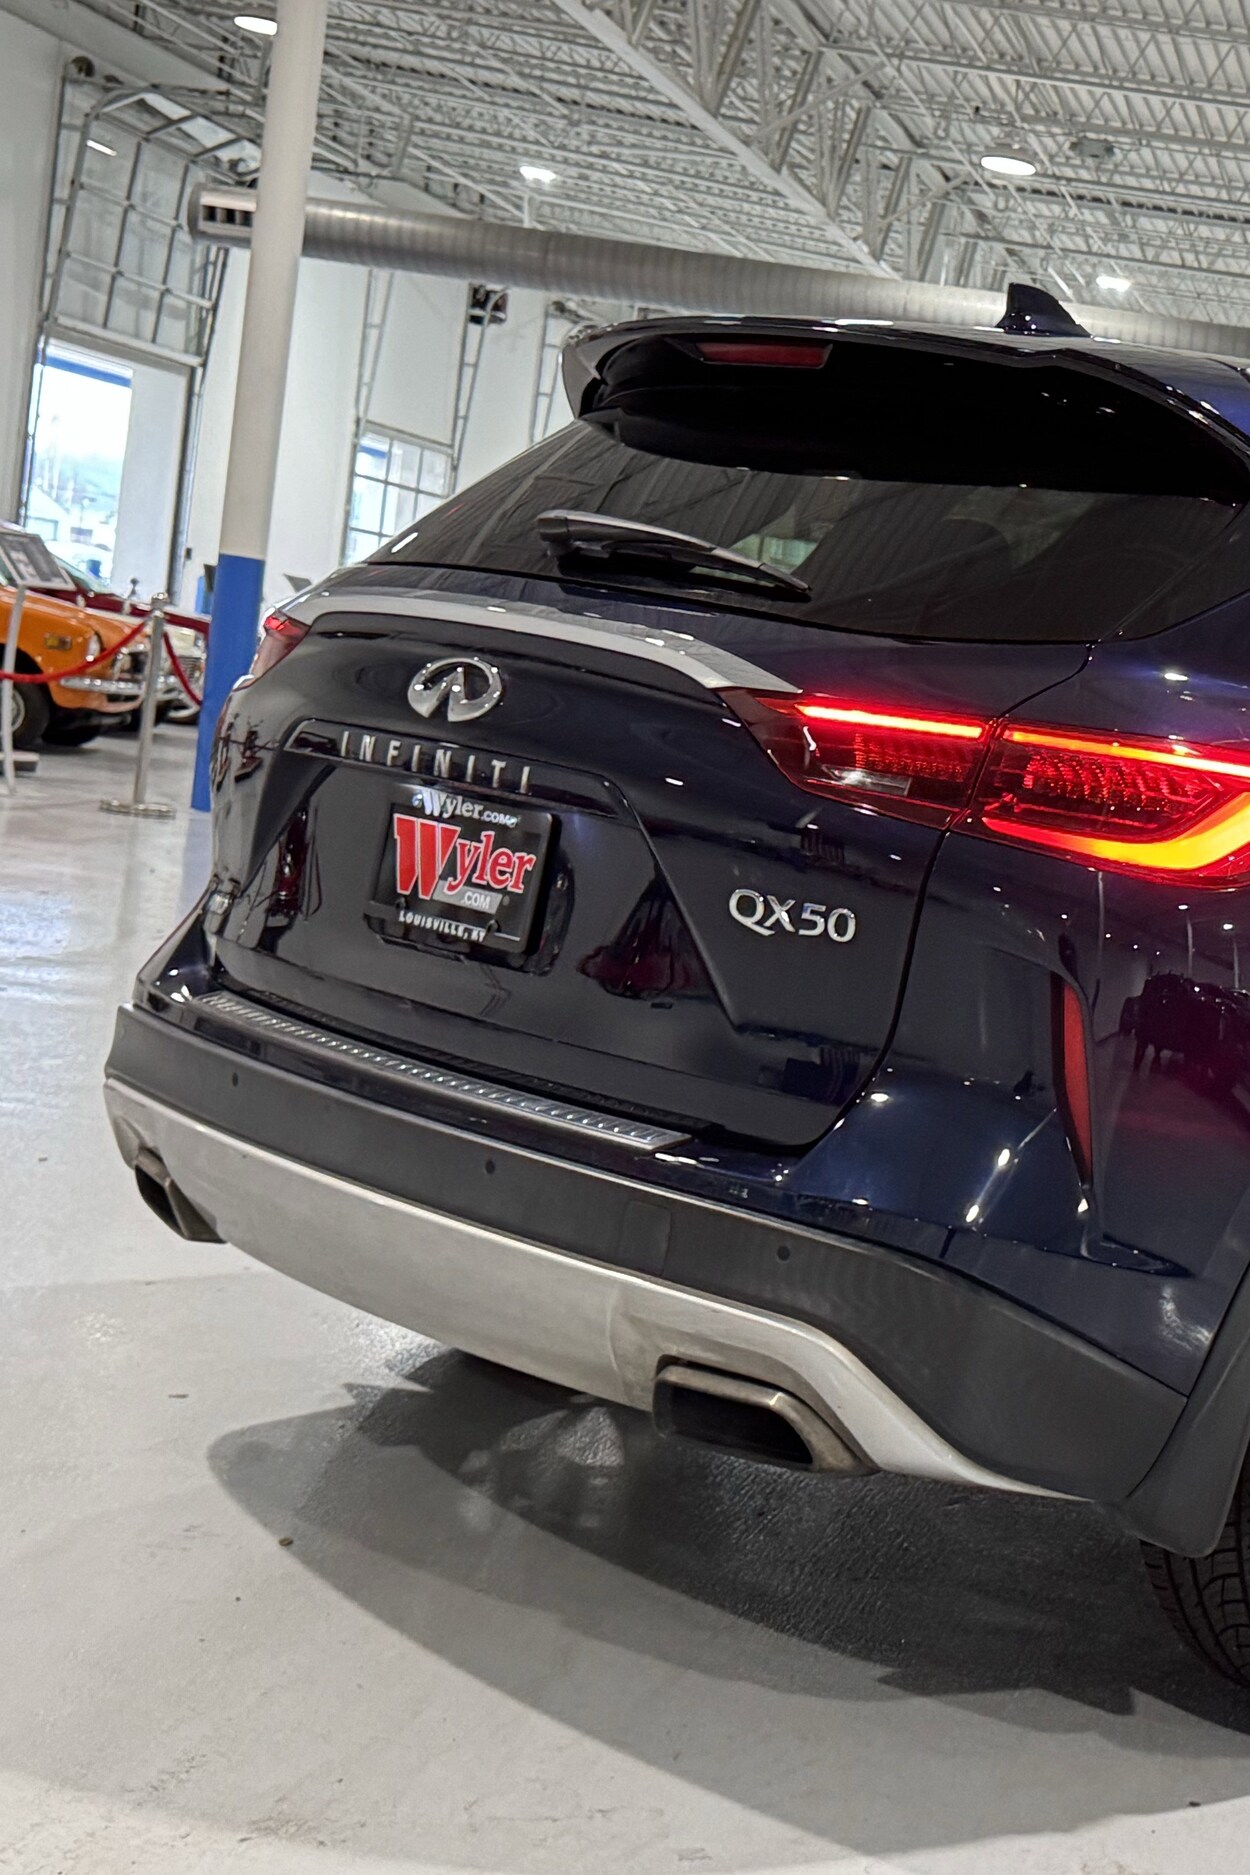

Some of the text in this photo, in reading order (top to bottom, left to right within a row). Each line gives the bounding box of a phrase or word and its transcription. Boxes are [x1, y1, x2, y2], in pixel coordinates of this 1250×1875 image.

[340, 731, 530, 794] INFINITI
[393, 814, 536, 900] Wyler
[398, 910, 469, 940] LOUISVILLE,
[729, 889, 856, 943] QX50
